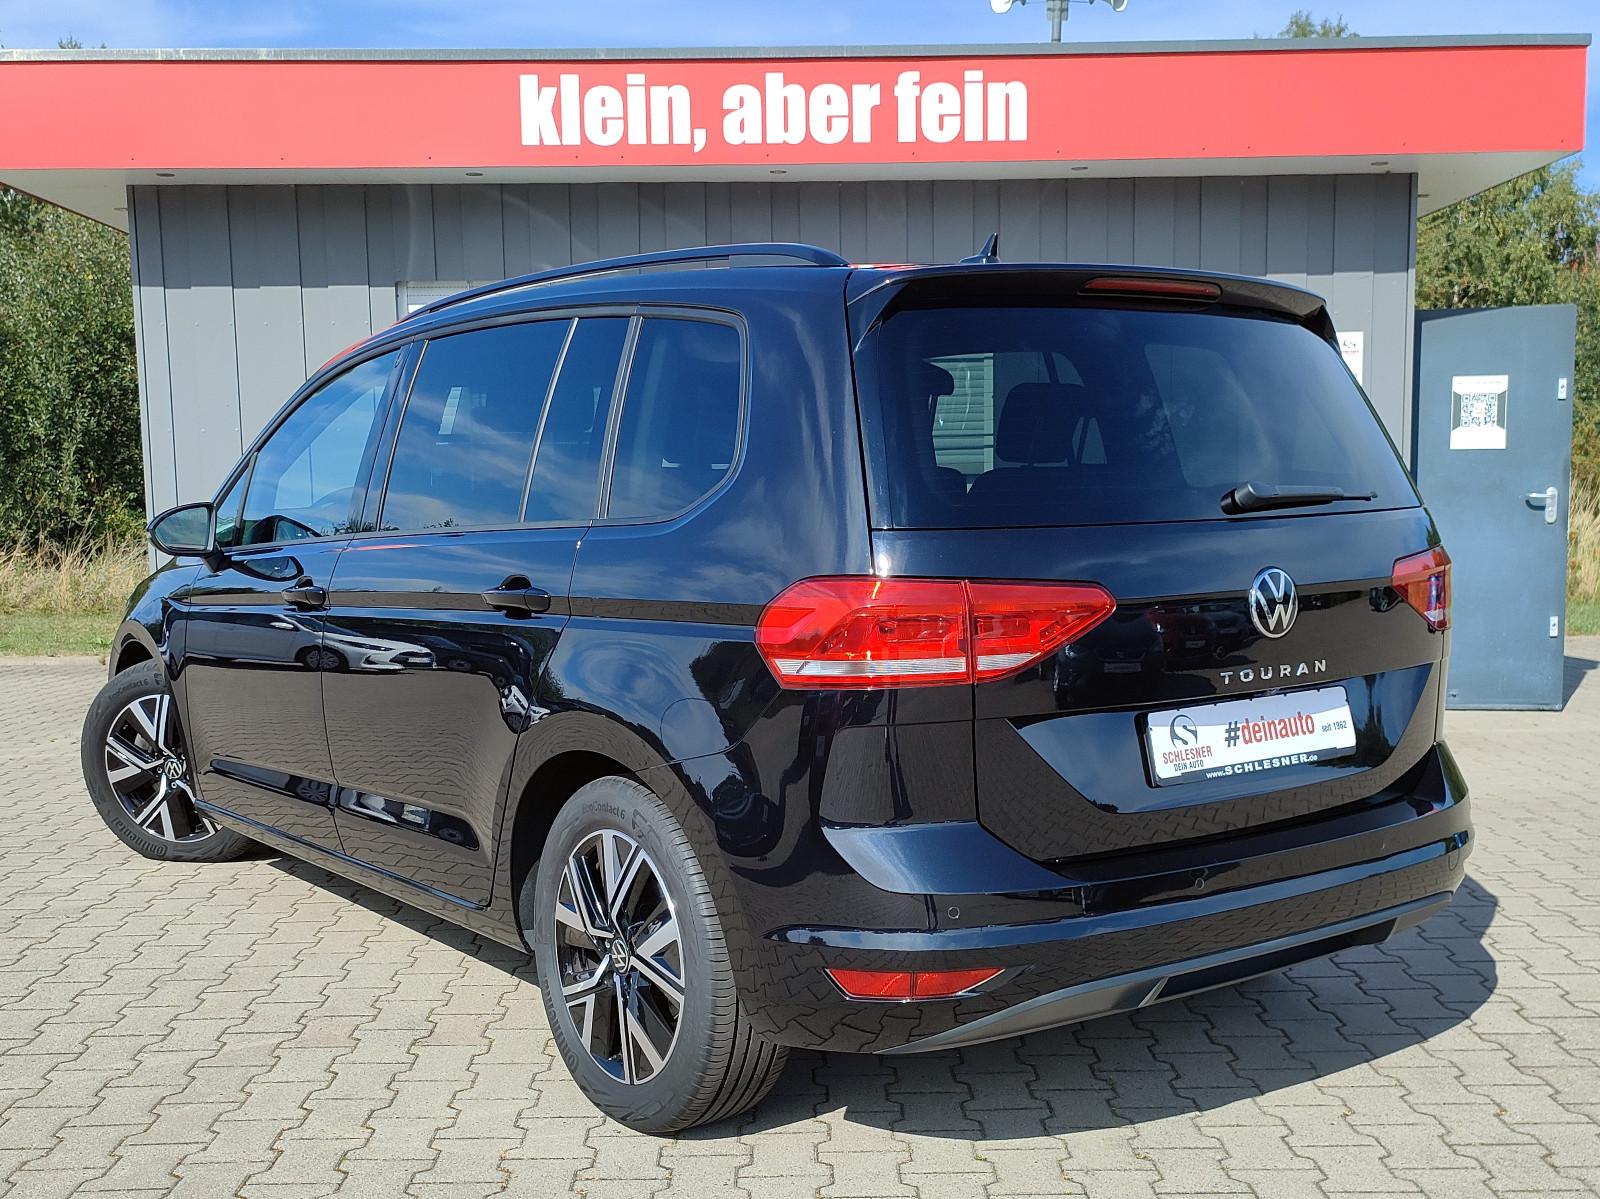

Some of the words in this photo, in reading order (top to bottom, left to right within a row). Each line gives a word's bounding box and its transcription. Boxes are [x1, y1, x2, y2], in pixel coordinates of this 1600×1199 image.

[519, 73, 707, 152] klein,
[722, 71, 881, 145] aber
[894, 69, 1028, 143] fein
[1220, 659, 1327, 685] TOURAN
[1225, 711, 1315, 747] #deinauto
[1321, 722, 1332, 732] seit
[1333, 720, 1347, 730] 1962
[1162, 745, 1213, 764] SCHLESNER
[1174, 762, 1188, 771] DEIN
[1189, 759, 1204, 769] AUTO
[1206, 753, 1318, 779] www.SCHLESNER.de
[620, 809, 626, 820] 6
